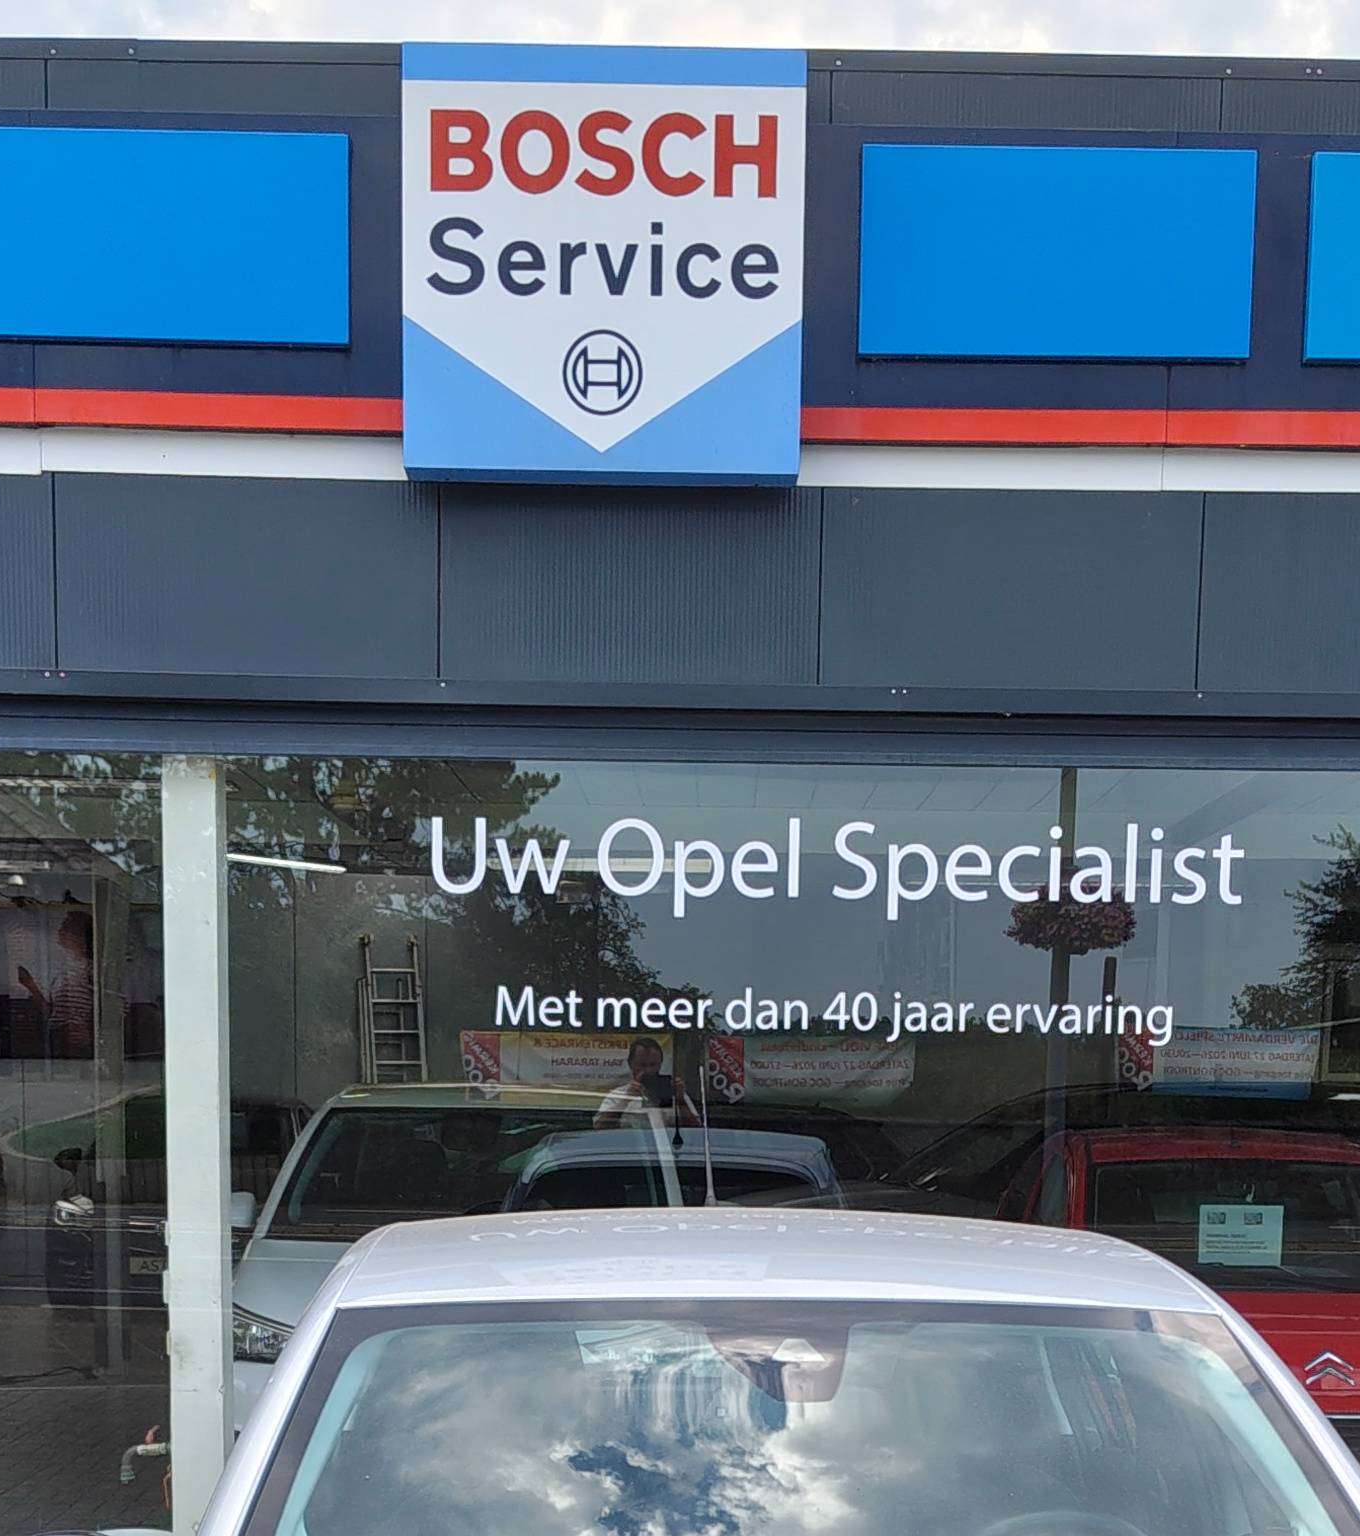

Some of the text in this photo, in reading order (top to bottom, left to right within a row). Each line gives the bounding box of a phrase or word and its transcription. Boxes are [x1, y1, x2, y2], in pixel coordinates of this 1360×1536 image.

[430, 109, 778, 198] BOSCH
[427, 217, 779, 300] Service
[430, 816, 1246, 921] Uw Opel Specialist
[495, 986, 1174, 1047] Met meer dan 40 jaar ervaring
